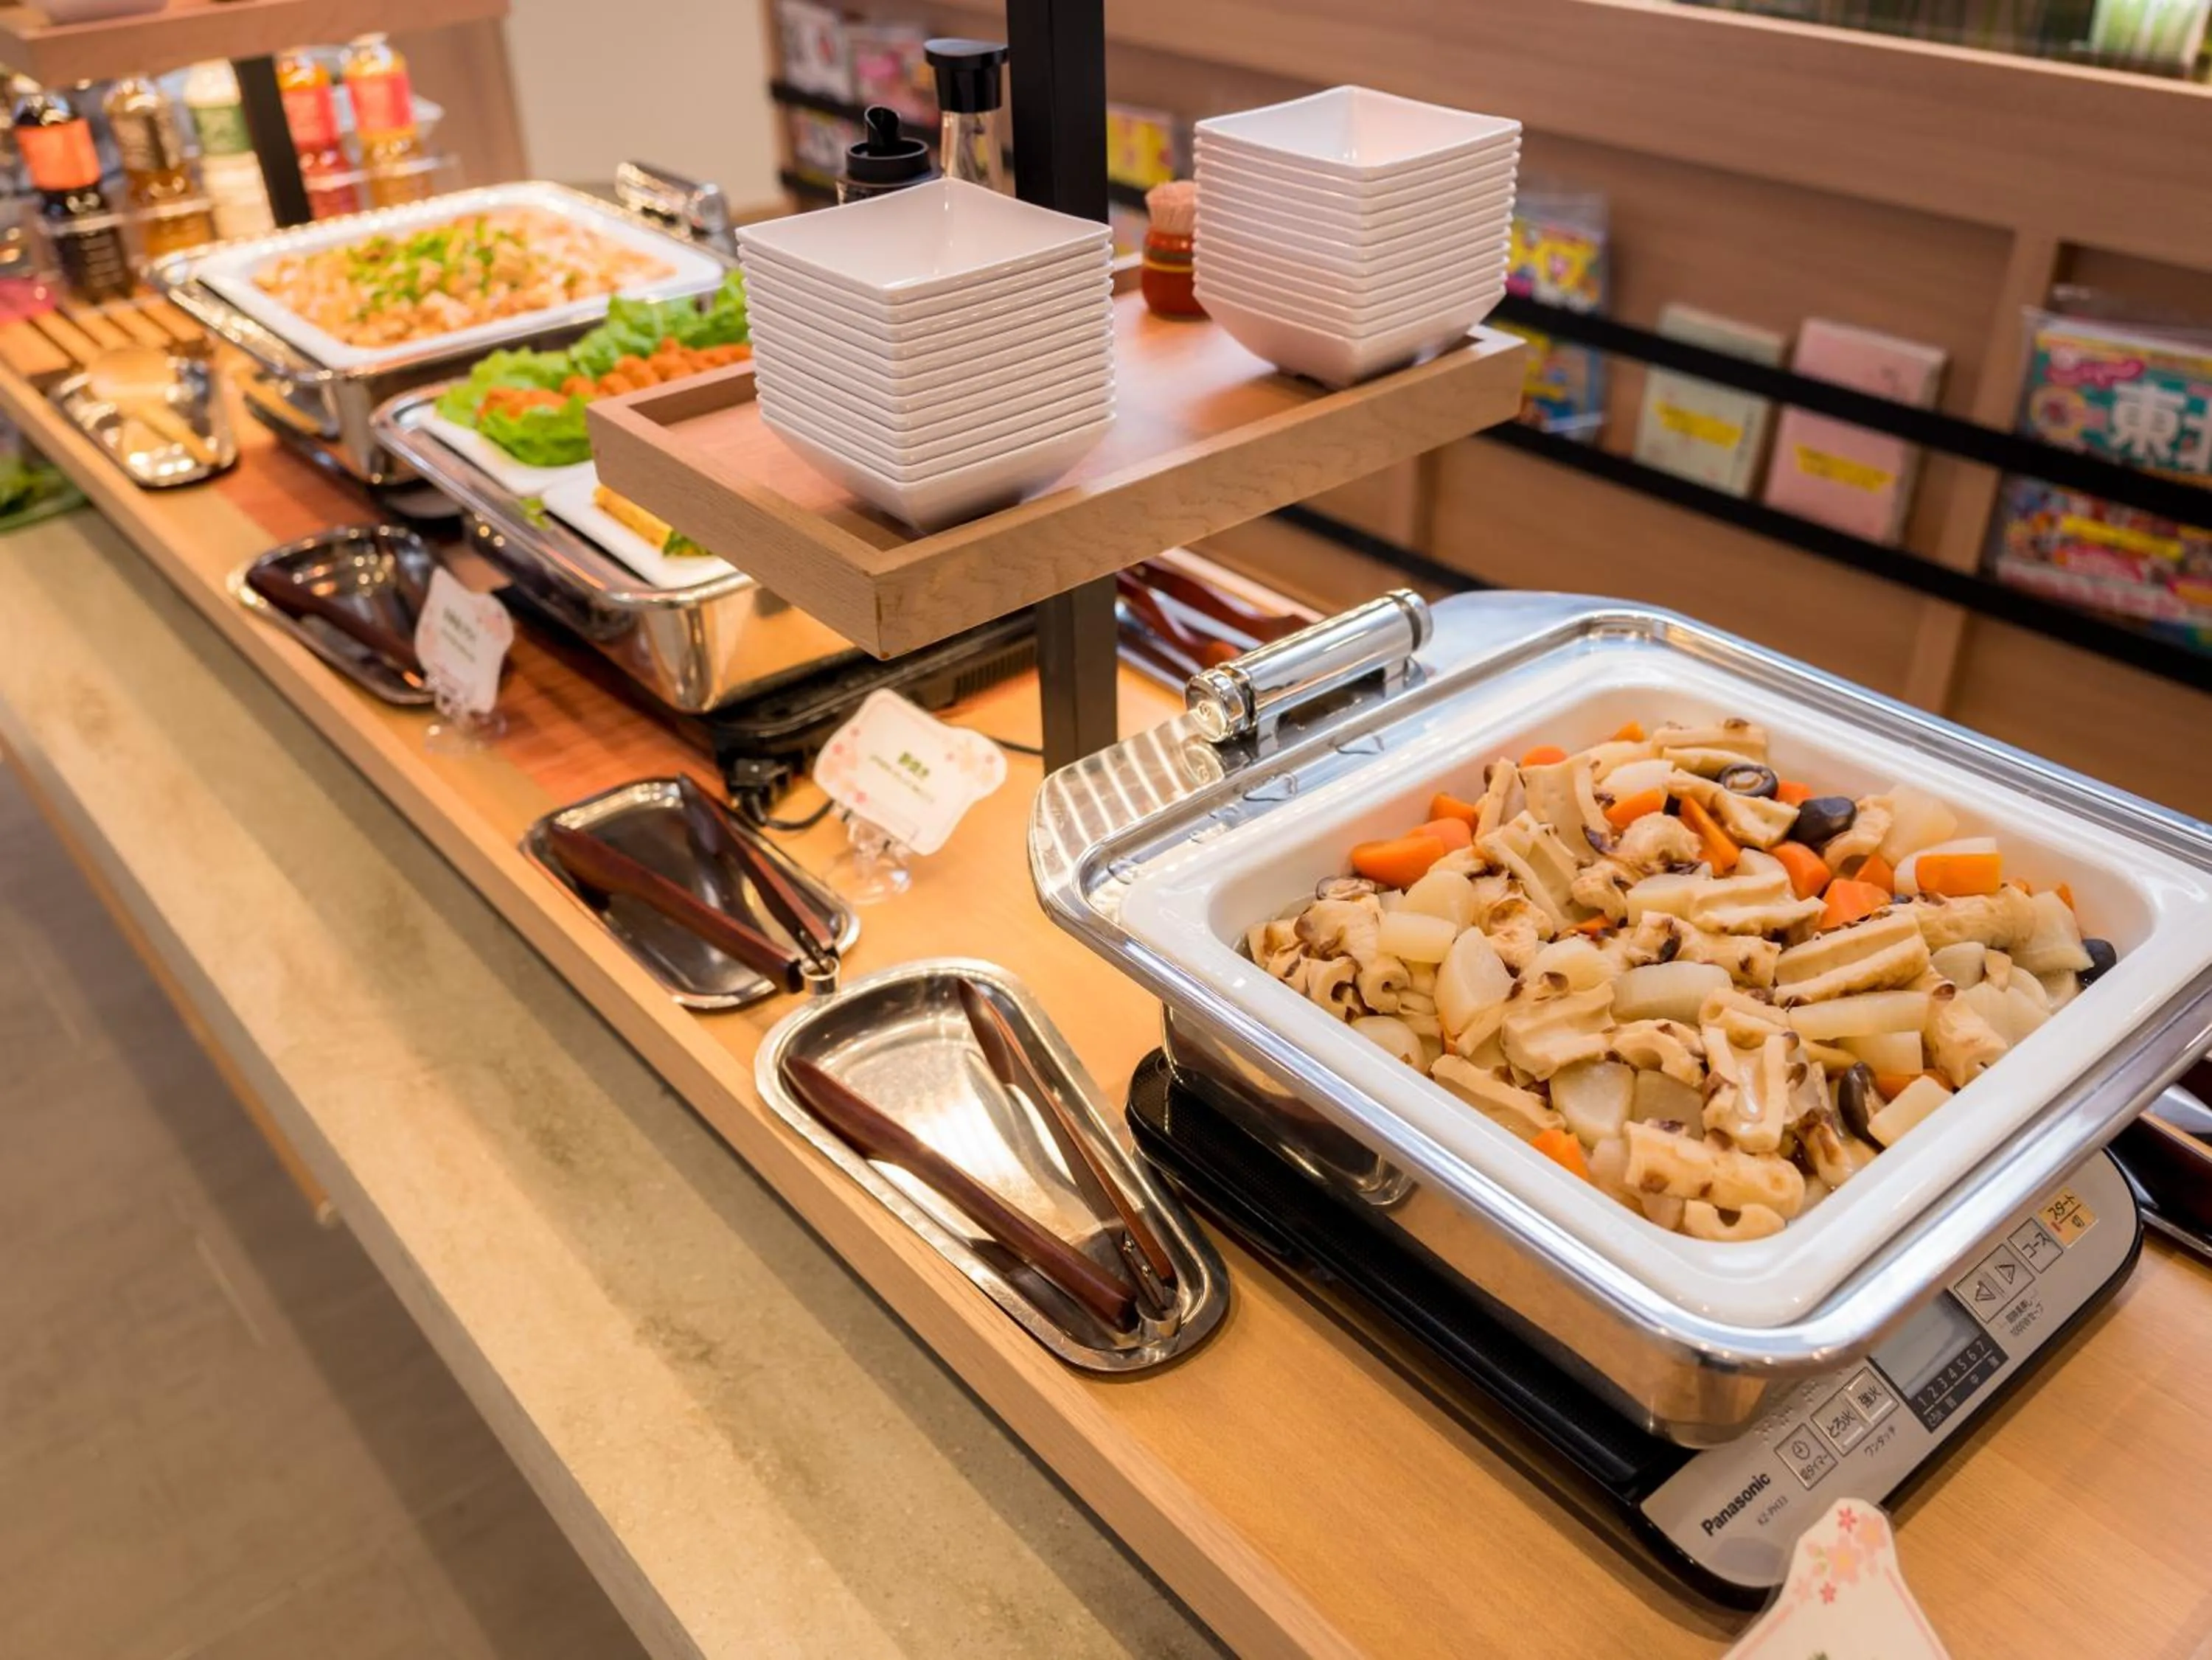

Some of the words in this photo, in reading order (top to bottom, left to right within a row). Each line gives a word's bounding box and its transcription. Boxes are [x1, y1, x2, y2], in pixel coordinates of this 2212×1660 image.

[2048, 1194, 2076, 1220] スタート
[2022, 1232, 2053, 1259] コース
[1918, 1396, 1927, 1406] 1
[1927, 1387, 1939, 1398] 2
[1938, 1377, 1948, 1389] 3
[1948, 1367, 1958, 1380] 4
[1956, 1359, 1967, 1370] 5
[1966, 1350, 1977, 1361] 6
[1976, 1340, 1986, 1352] 7
[1826, 1410, 1857, 1438] とろ火
[1857, 1385, 1882, 1409] 強火
[1863, 1425, 1896, 1457] ワンタッチ
[1701, 1473, 1771, 1536] Panasonic
